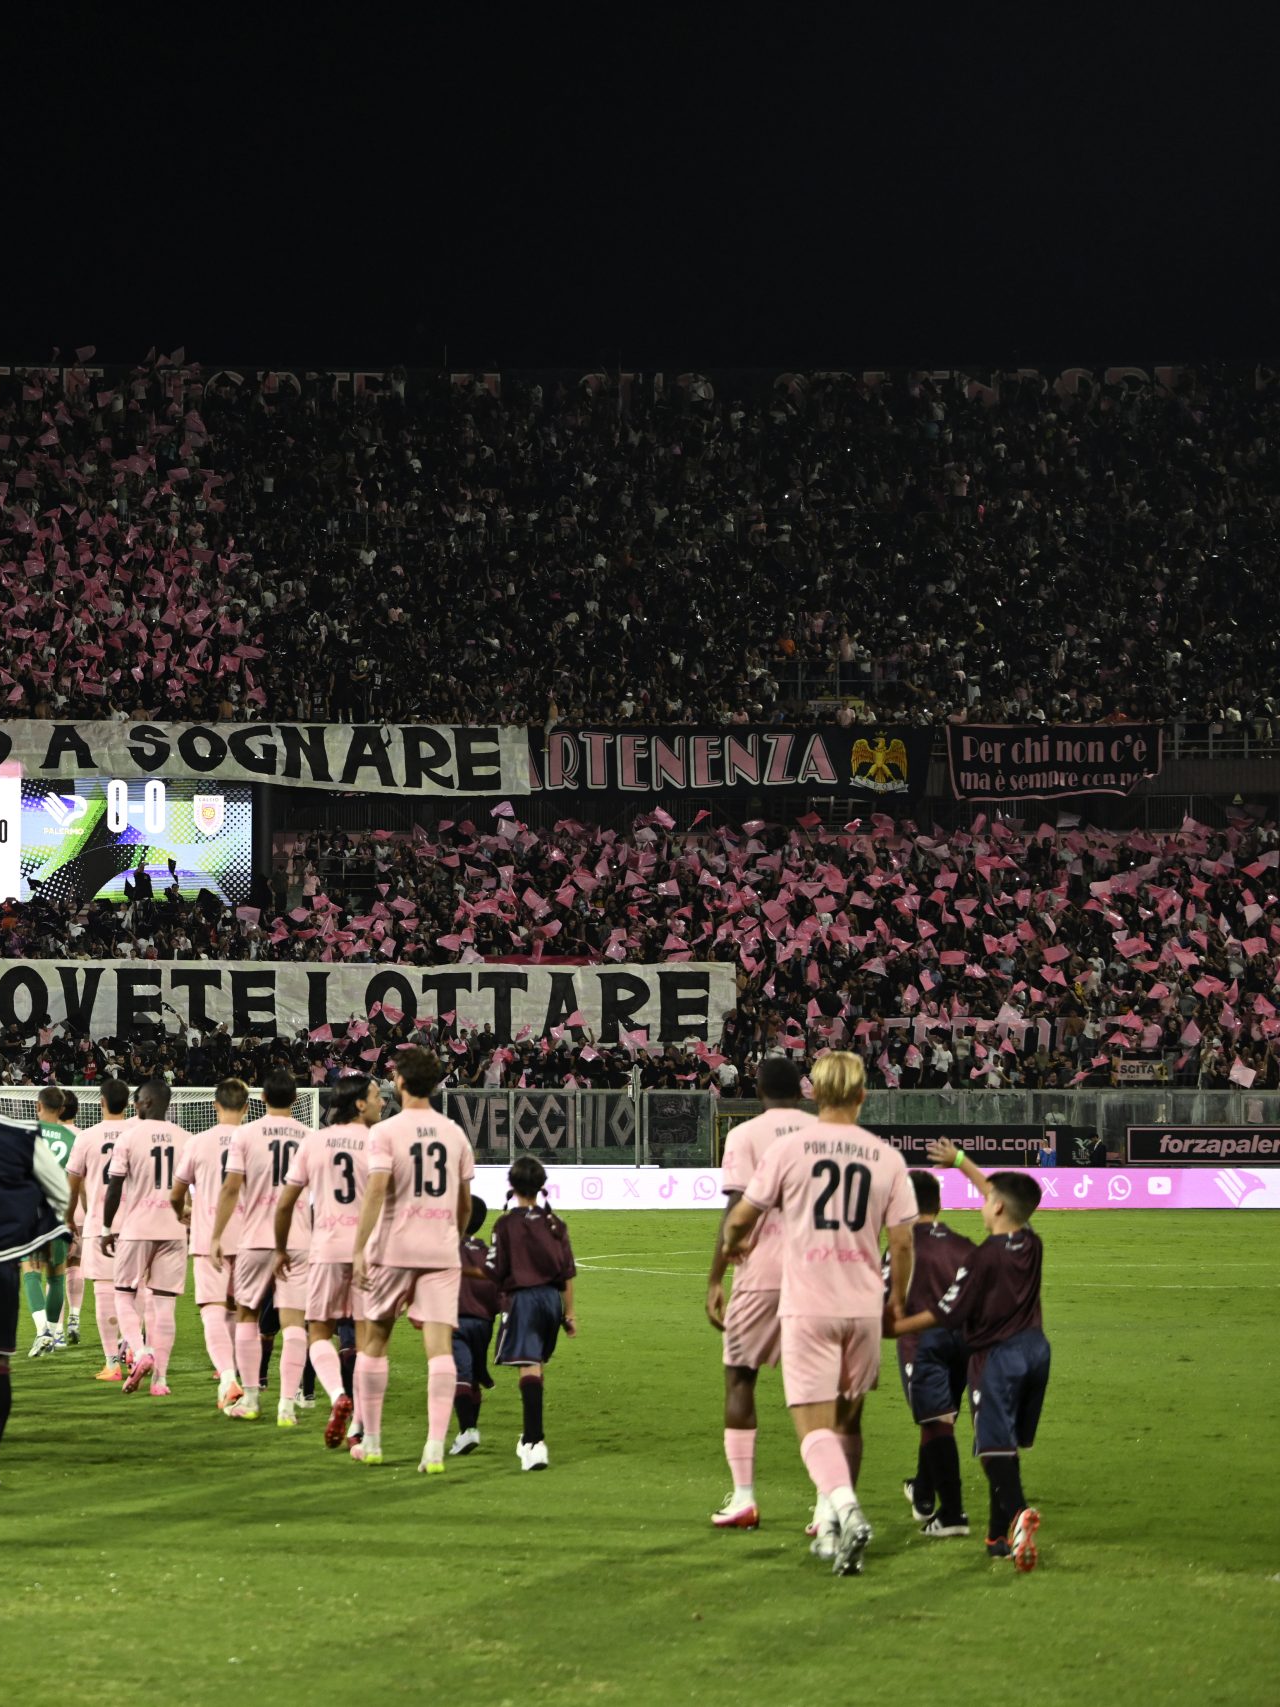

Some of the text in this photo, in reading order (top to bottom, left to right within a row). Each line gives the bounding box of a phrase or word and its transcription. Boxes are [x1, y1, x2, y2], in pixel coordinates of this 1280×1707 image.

[38, 724, 99, 770] A
[128, 724, 503, 791] SOGNARE
[529, 731, 839, 792] RTENENZA
[962, 735, 1006, 764] Per
[1011, 734, 1050, 764] chi
[1056, 740, 1105, 764] non
[960, 771, 991, 791] ma
[995, 769, 1006, 791] è
[1010, 770, 1079, 790] sempre
[1083, 773, 1116, 786] con
[43, 827, 85, 836] PALERMO
[307, 969, 711, 1044] LOTTARE
[1120, 1064, 1155, 1075] SCITA
[454, 1093, 636, 1150] VECCHIO
[150, 1145, 174, 1190] 11
[333, 1151, 356, 1205] 3
[409, 1141, 448, 1198] 13
[811, 1158, 872, 1233] 20
